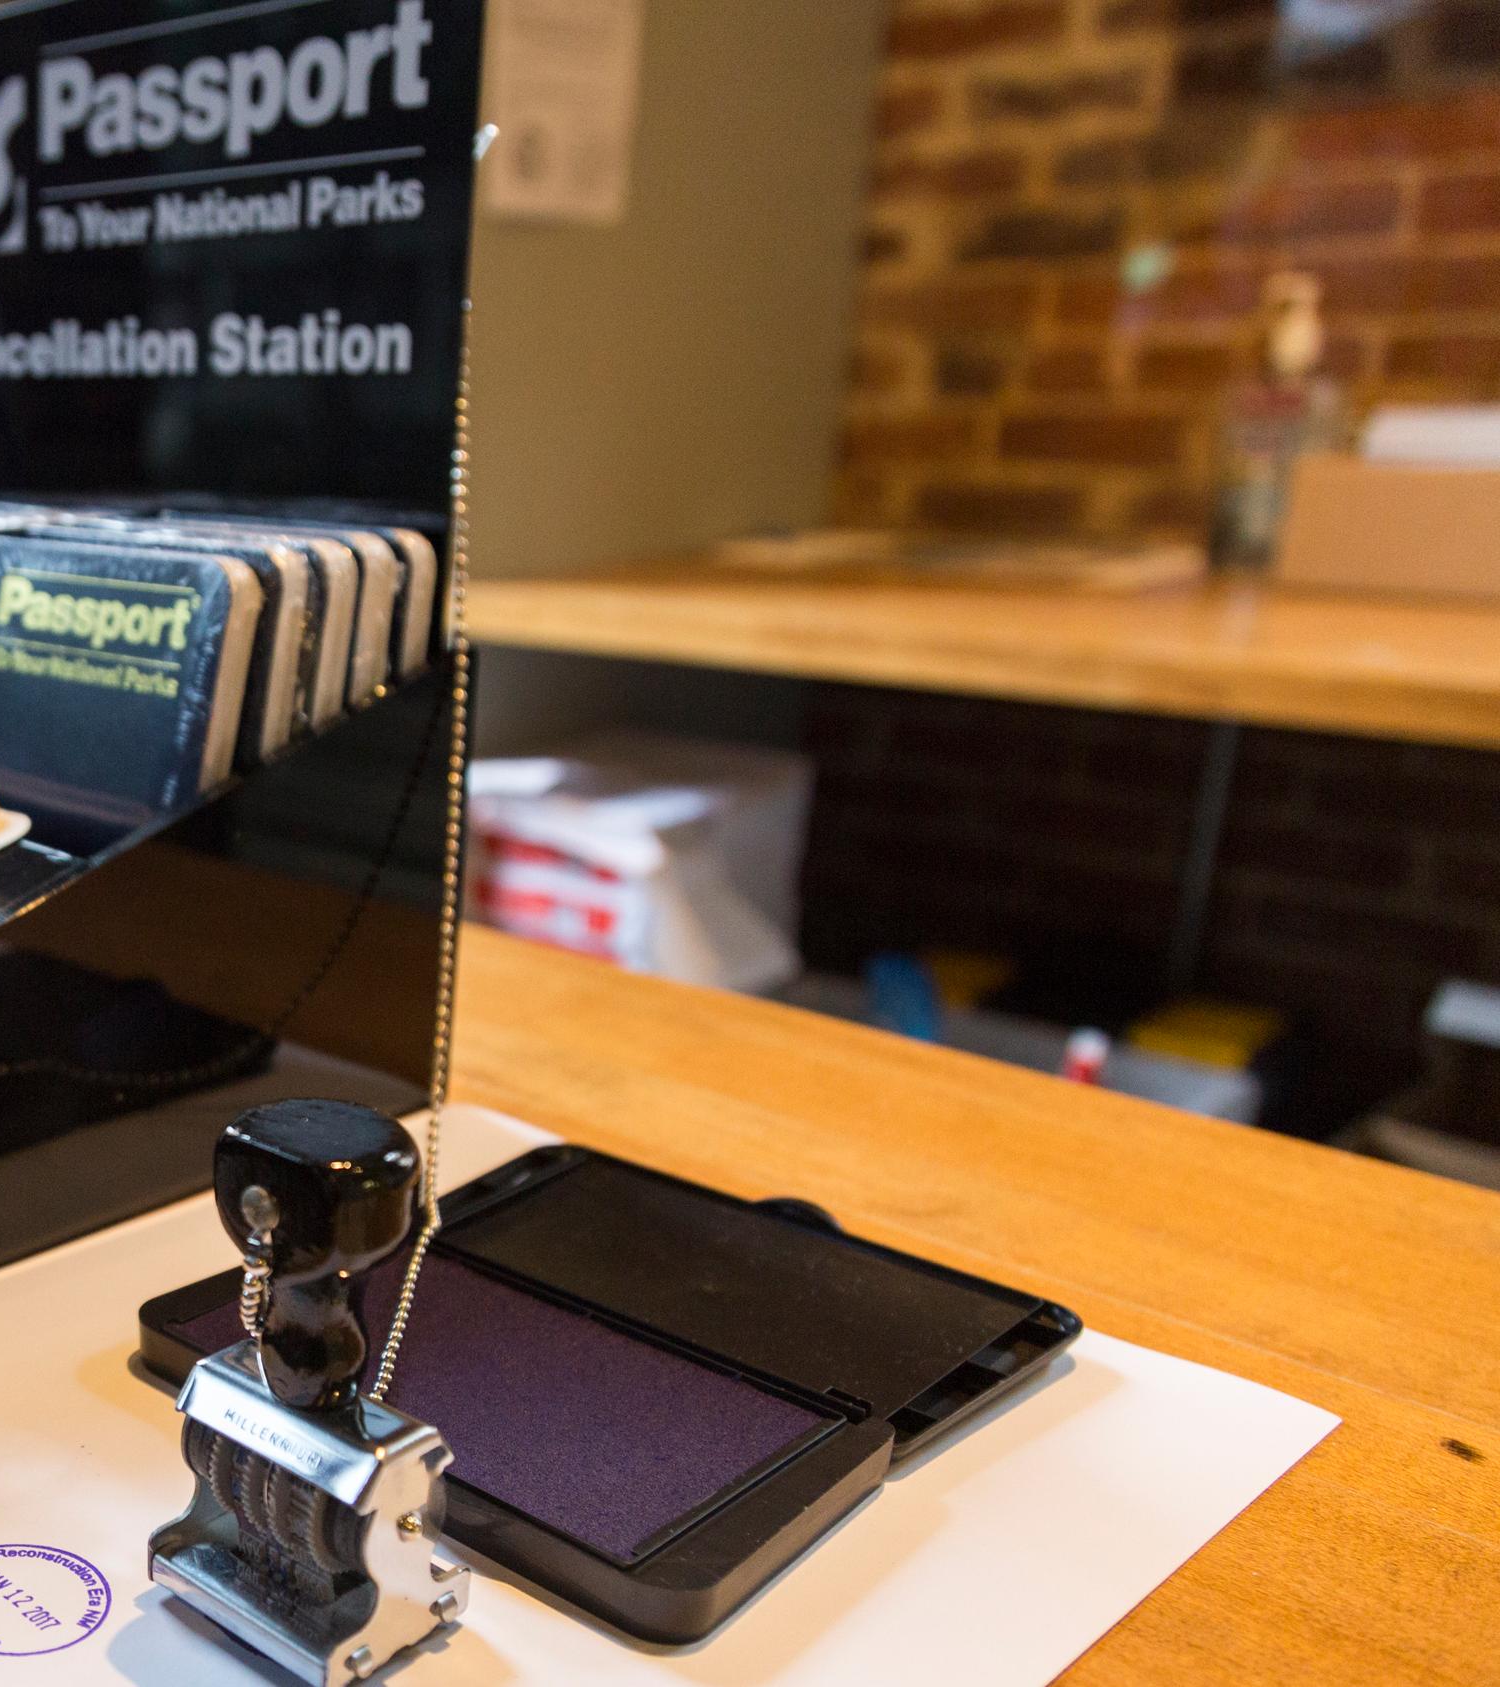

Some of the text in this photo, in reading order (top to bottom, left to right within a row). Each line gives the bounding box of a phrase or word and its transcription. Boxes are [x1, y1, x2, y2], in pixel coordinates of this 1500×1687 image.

[37, 0, 432, 163] Passport
[37, 169, 425, 252] To Your National Parks
[209, 309, 412, 376] Station
[123, 664, 180, 699] Parks
[88, 1587, 104, 1608] Era
[21, 1606, 62, 1631] 2017
[76, 1609, 102, 1630] NM
